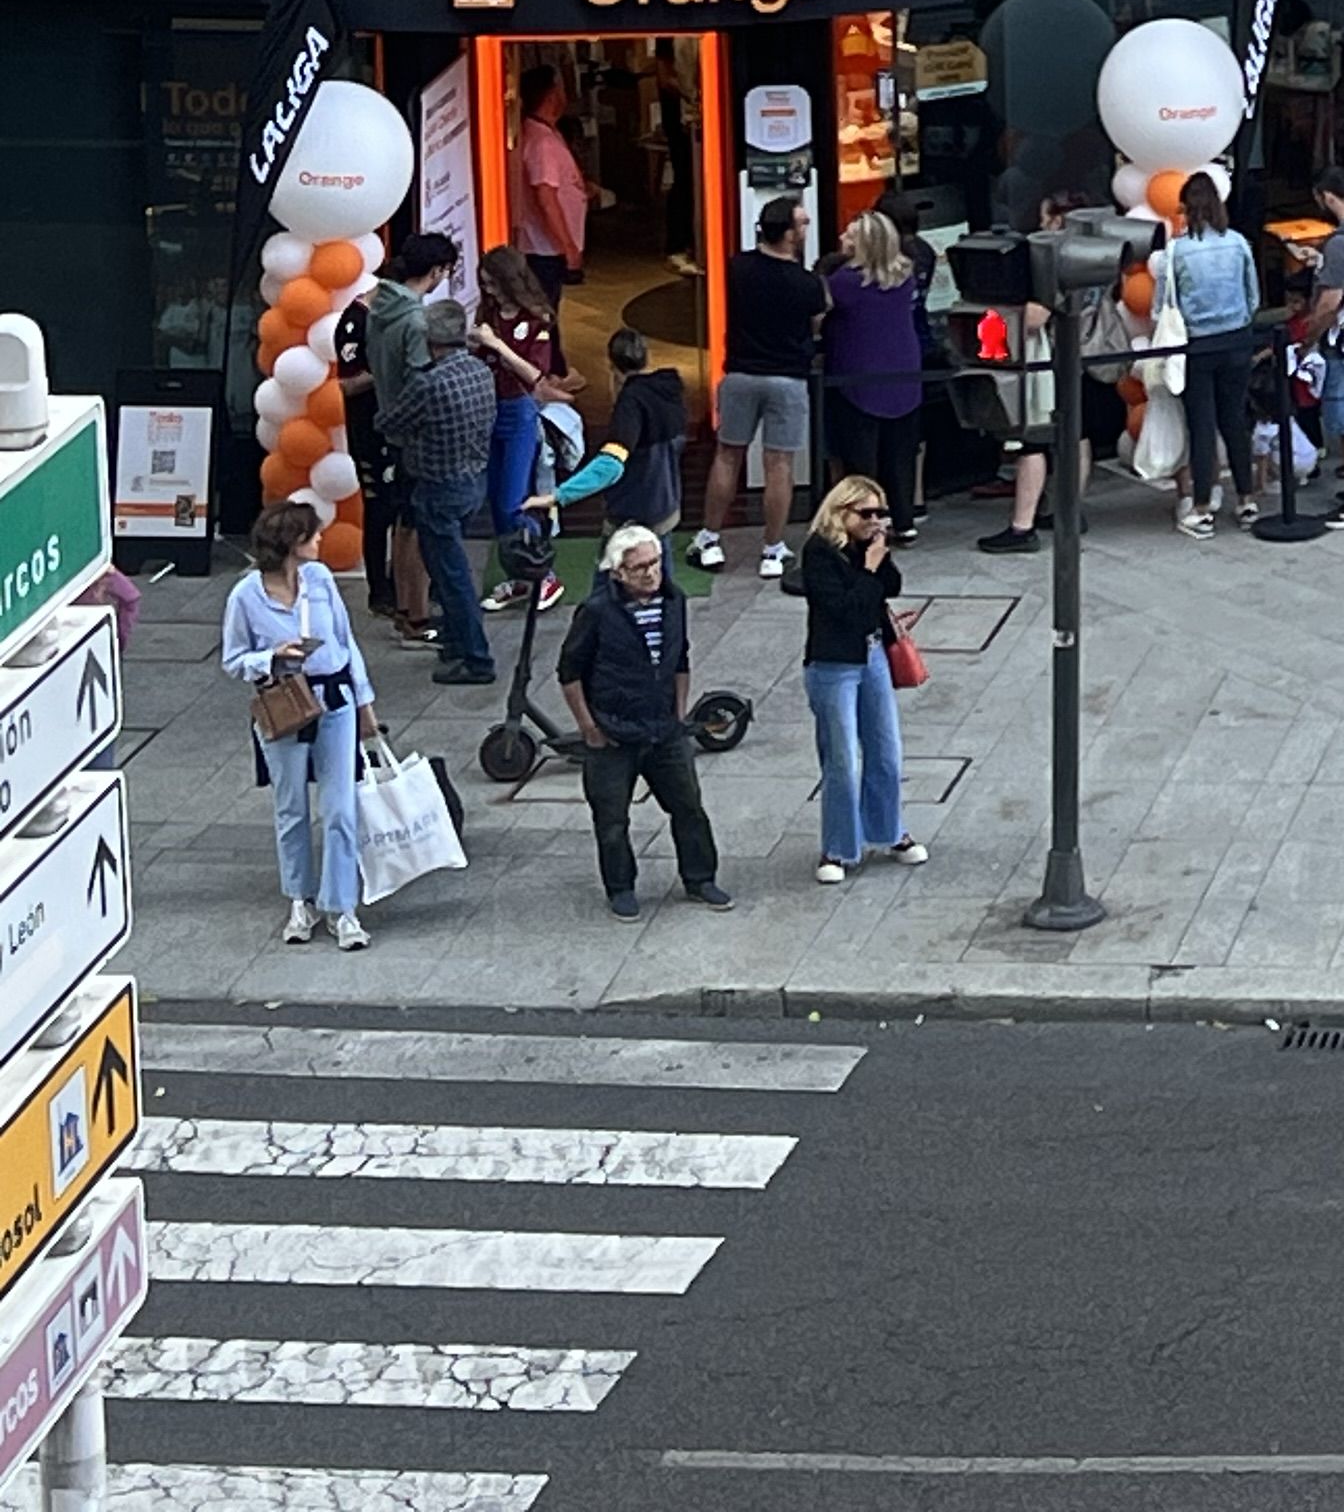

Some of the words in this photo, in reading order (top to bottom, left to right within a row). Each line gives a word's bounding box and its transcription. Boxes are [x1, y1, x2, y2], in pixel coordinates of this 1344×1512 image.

[250, 26, 329, 184] LALIGA
[299, 172, 365, 189] Orange
[8, 901, 45, 955] León
[0, 1182, 42, 1269] osol
